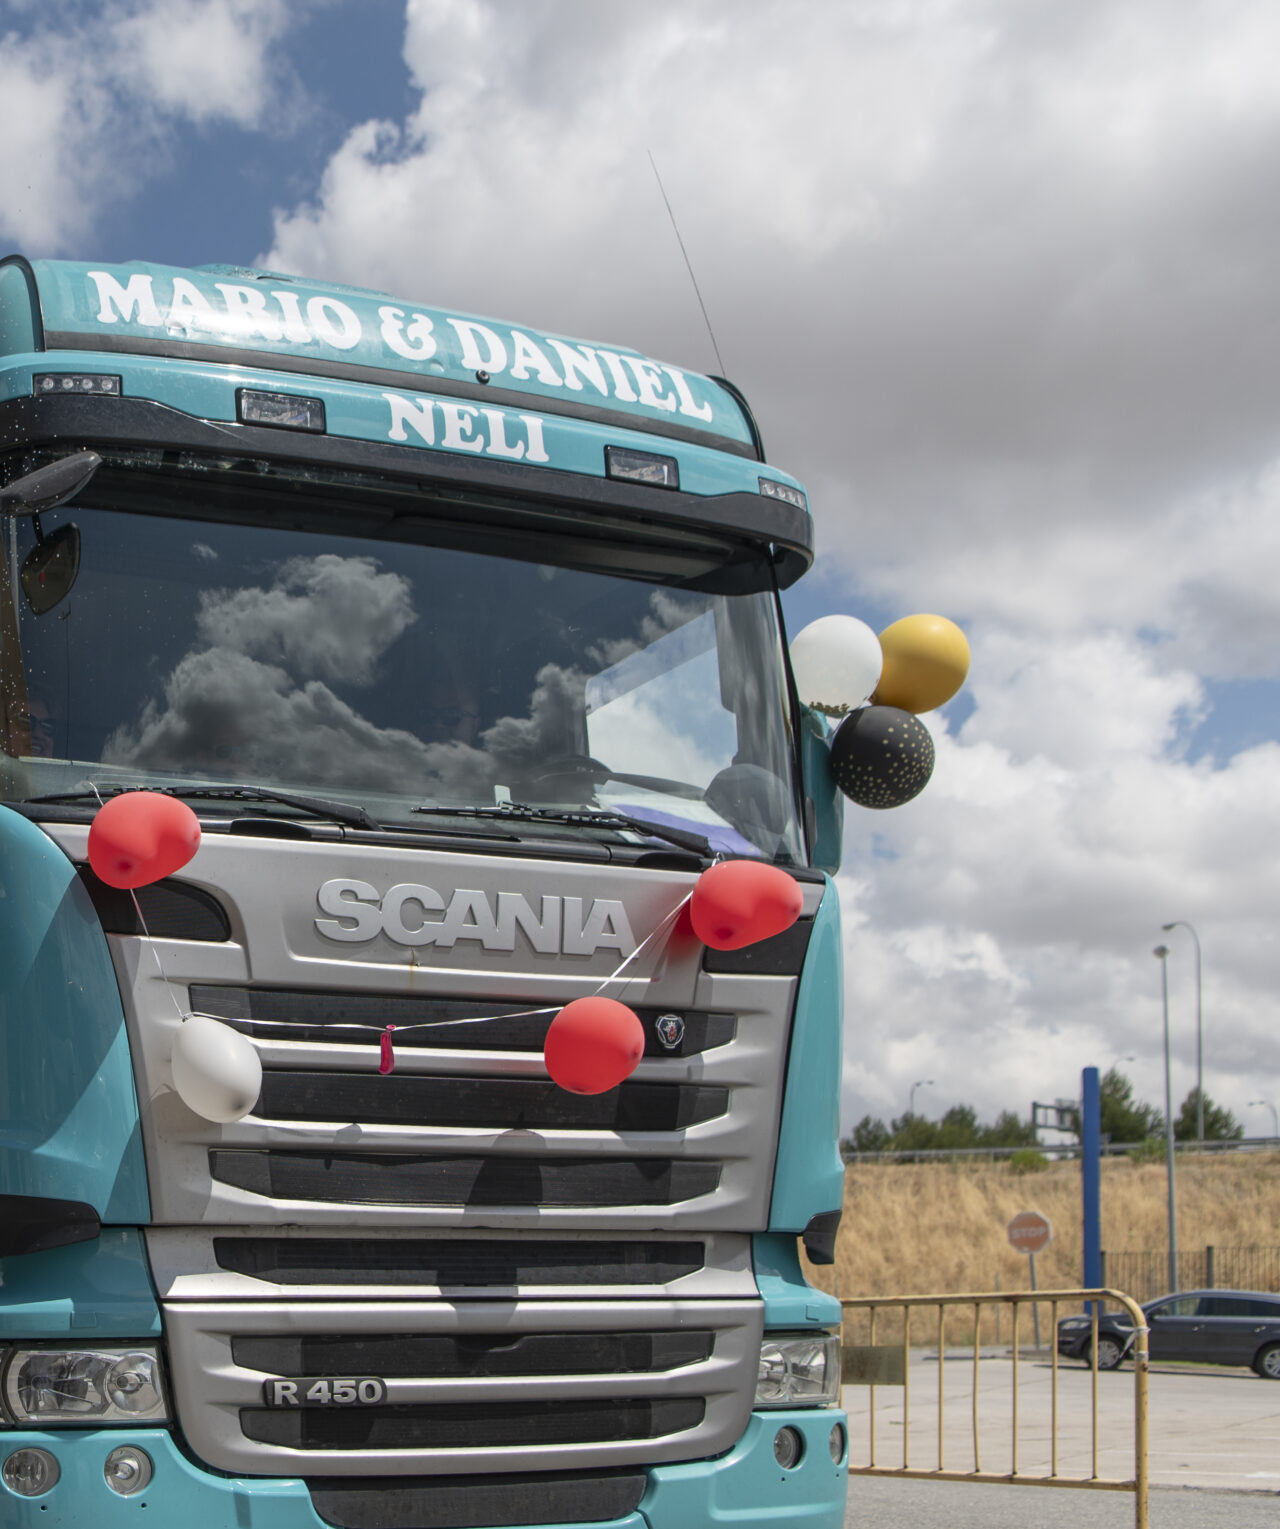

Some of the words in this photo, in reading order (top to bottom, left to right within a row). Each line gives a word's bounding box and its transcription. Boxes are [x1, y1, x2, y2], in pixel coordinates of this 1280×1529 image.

[87, 271, 363, 350] MARIO
[380, 308, 437, 361] &
[445, 316, 714, 423] DANIEL
[382, 393, 550, 463] NELI
[313, 878, 638, 957] SCANIA
[1012, 1226, 1046, 1240] STOP
[272, 1381, 298, 1405] R
[306, 1379, 384, 1404] 450
